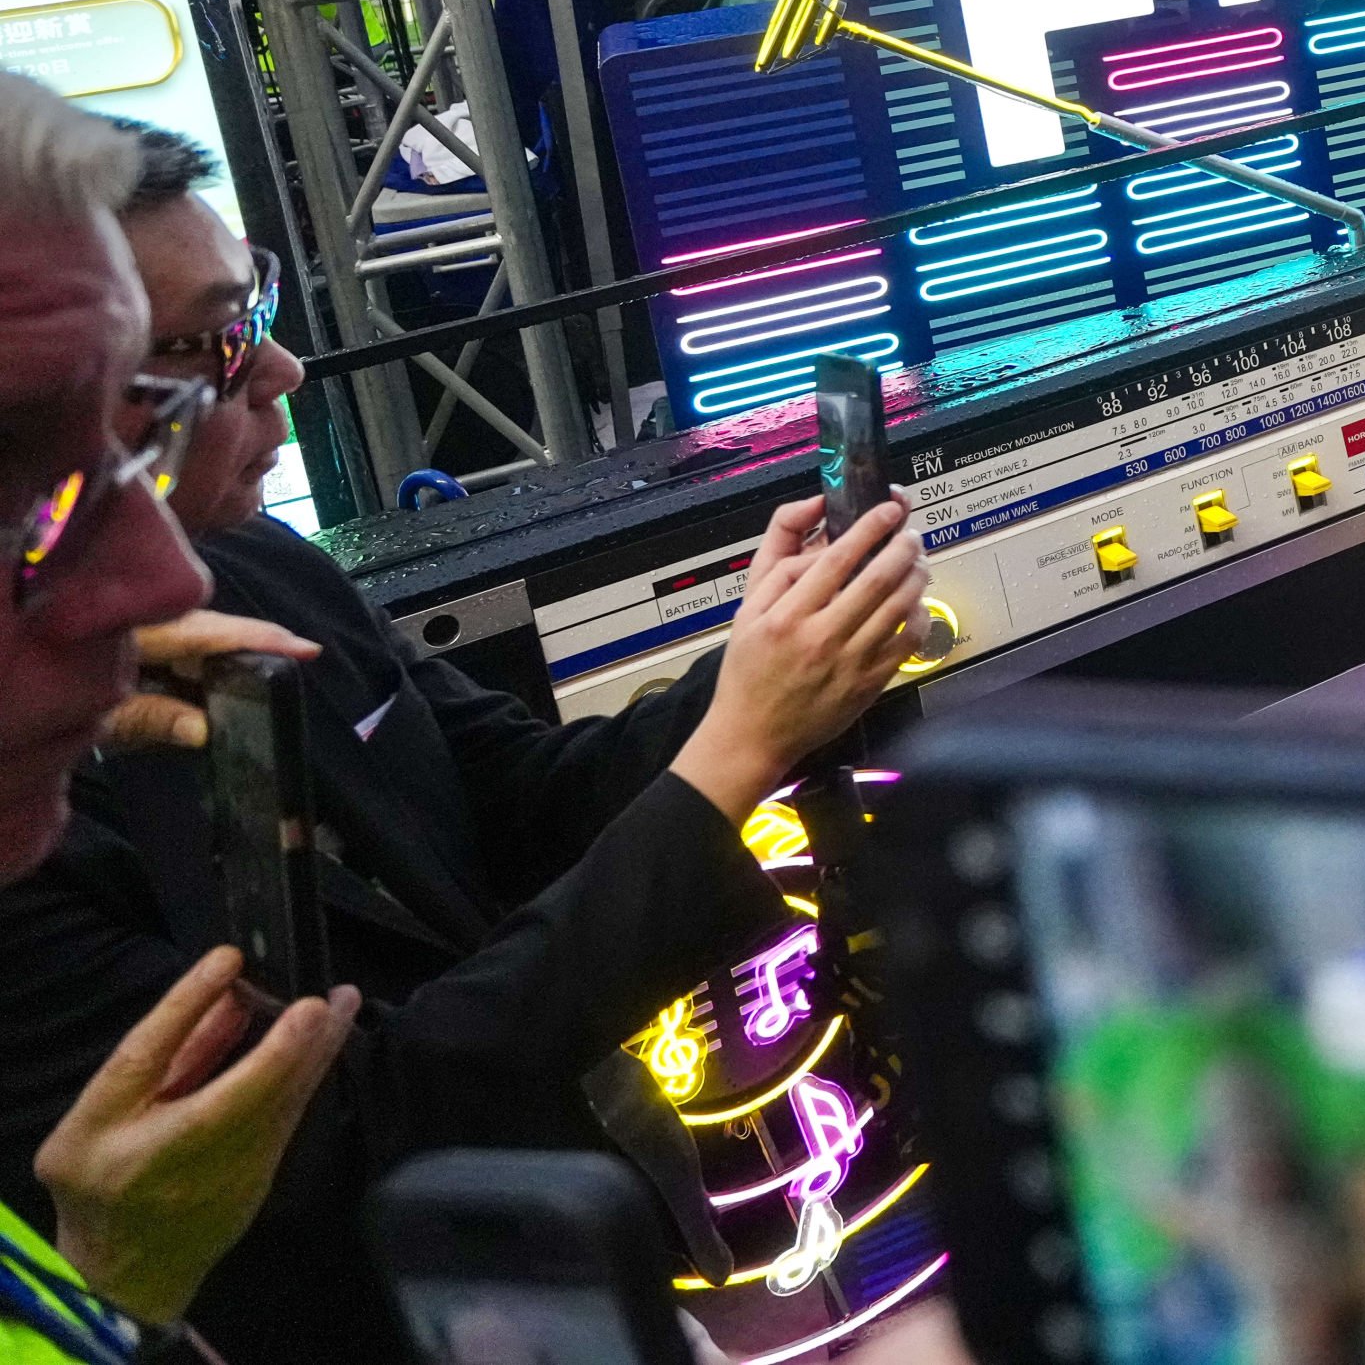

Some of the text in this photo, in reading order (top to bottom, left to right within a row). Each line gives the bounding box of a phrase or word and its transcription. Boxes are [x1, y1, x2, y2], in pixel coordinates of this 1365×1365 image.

[0, 12, 93, 46] 迎新賞
[1097, 396, 1103, 404] 0
[1149, 379, 1155, 388] 2
[1226, 354, 1231, 362] 5
[1250, 346, 1256, 354] 6
[1322, 323, 1327, 331] 9
[1343, 316, 1351, 324] 10
[1101, 323, 1352, 416] 88 92 96 100 104 108
[1112, 347, 1358, 436] 7.5 8.0 9.0 10.0 12.0 14.0 16.0 18.0 20.0 22.0
[1118, 370, 1361, 461] 2.3 3.0 3.5 4.0 4.5 5.0 6.0 7.0 7.5
[1125, 459, 1148, 477] 530
[1164, 446, 1187, 463] 600
[1198, 434, 1221, 451] 700
[1225, 425, 1247, 442] 800
[1259, 411, 1286, 429] 1000
[1289, 400, 1315, 418] 1200
[1316, 391, 1342, 409] 1400
[1280, 434, 1325, 457] AM BAND
[911, 447, 944, 463] SCALE
[913, 421, 1075, 479] FM FREQUENCY MODULATION
[960, 470, 992, 488] SHORT
[994, 463, 1020, 476] WAVE
[1022, 458, 1028, 467] 2
[1180, 467, 1234, 492] FUNCTION
[966, 496, 998, 513] SHORT
[1000, 488, 1026, 501] WAVE
[1179, 505, 1191, 514] FM
[931, 500, 1039, 546] MW MEDIUM WAVE
[1091, 507, 1124, 526] MODE
[1184, 525, 1196, 534] AM
[1039, 542, 1091, 566] SPACE-WIDE
[1157, 540, 1199, 561] RADIO OFF
[1182, 548, 1201, 561] TAPE
[1061, 562, 1095, 581] STEREO
[1073, 582, 1099, 598] MONO
[665, 595, 714, 618] BATTERY
[952, 634, 973, 647] MAX
